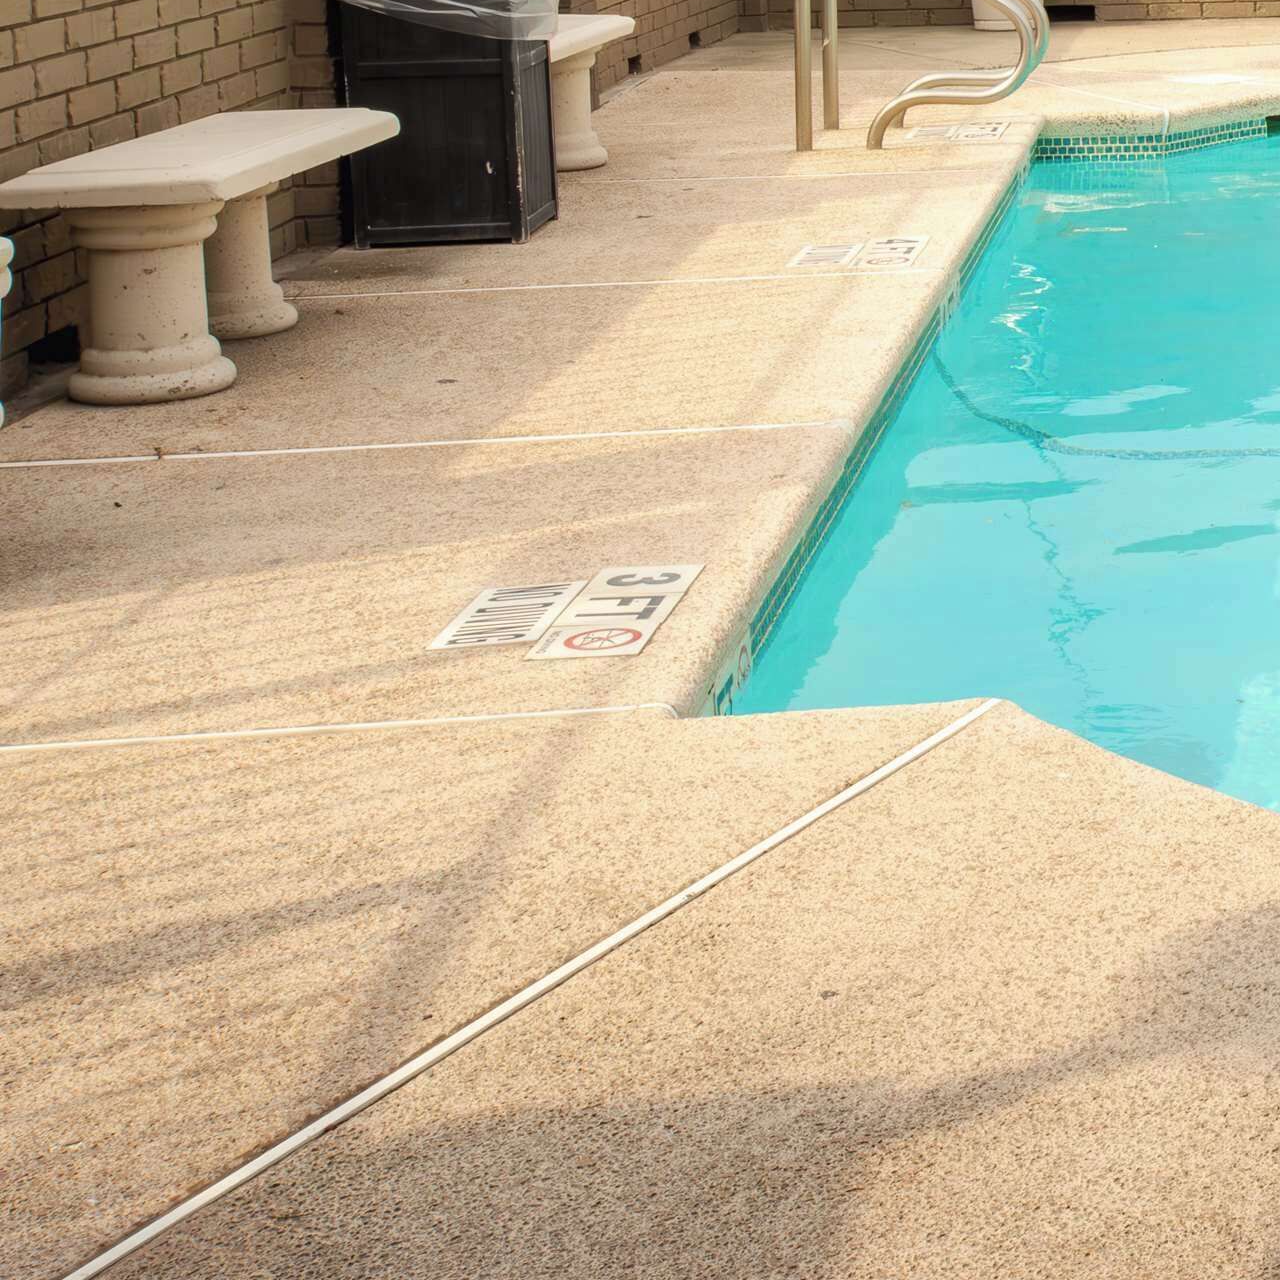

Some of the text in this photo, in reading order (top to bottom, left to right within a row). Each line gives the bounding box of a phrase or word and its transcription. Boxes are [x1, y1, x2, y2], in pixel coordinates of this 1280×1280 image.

[446, 583, 571, 646] NO DIVING
[574, 572, 682, 621] 3 FT
